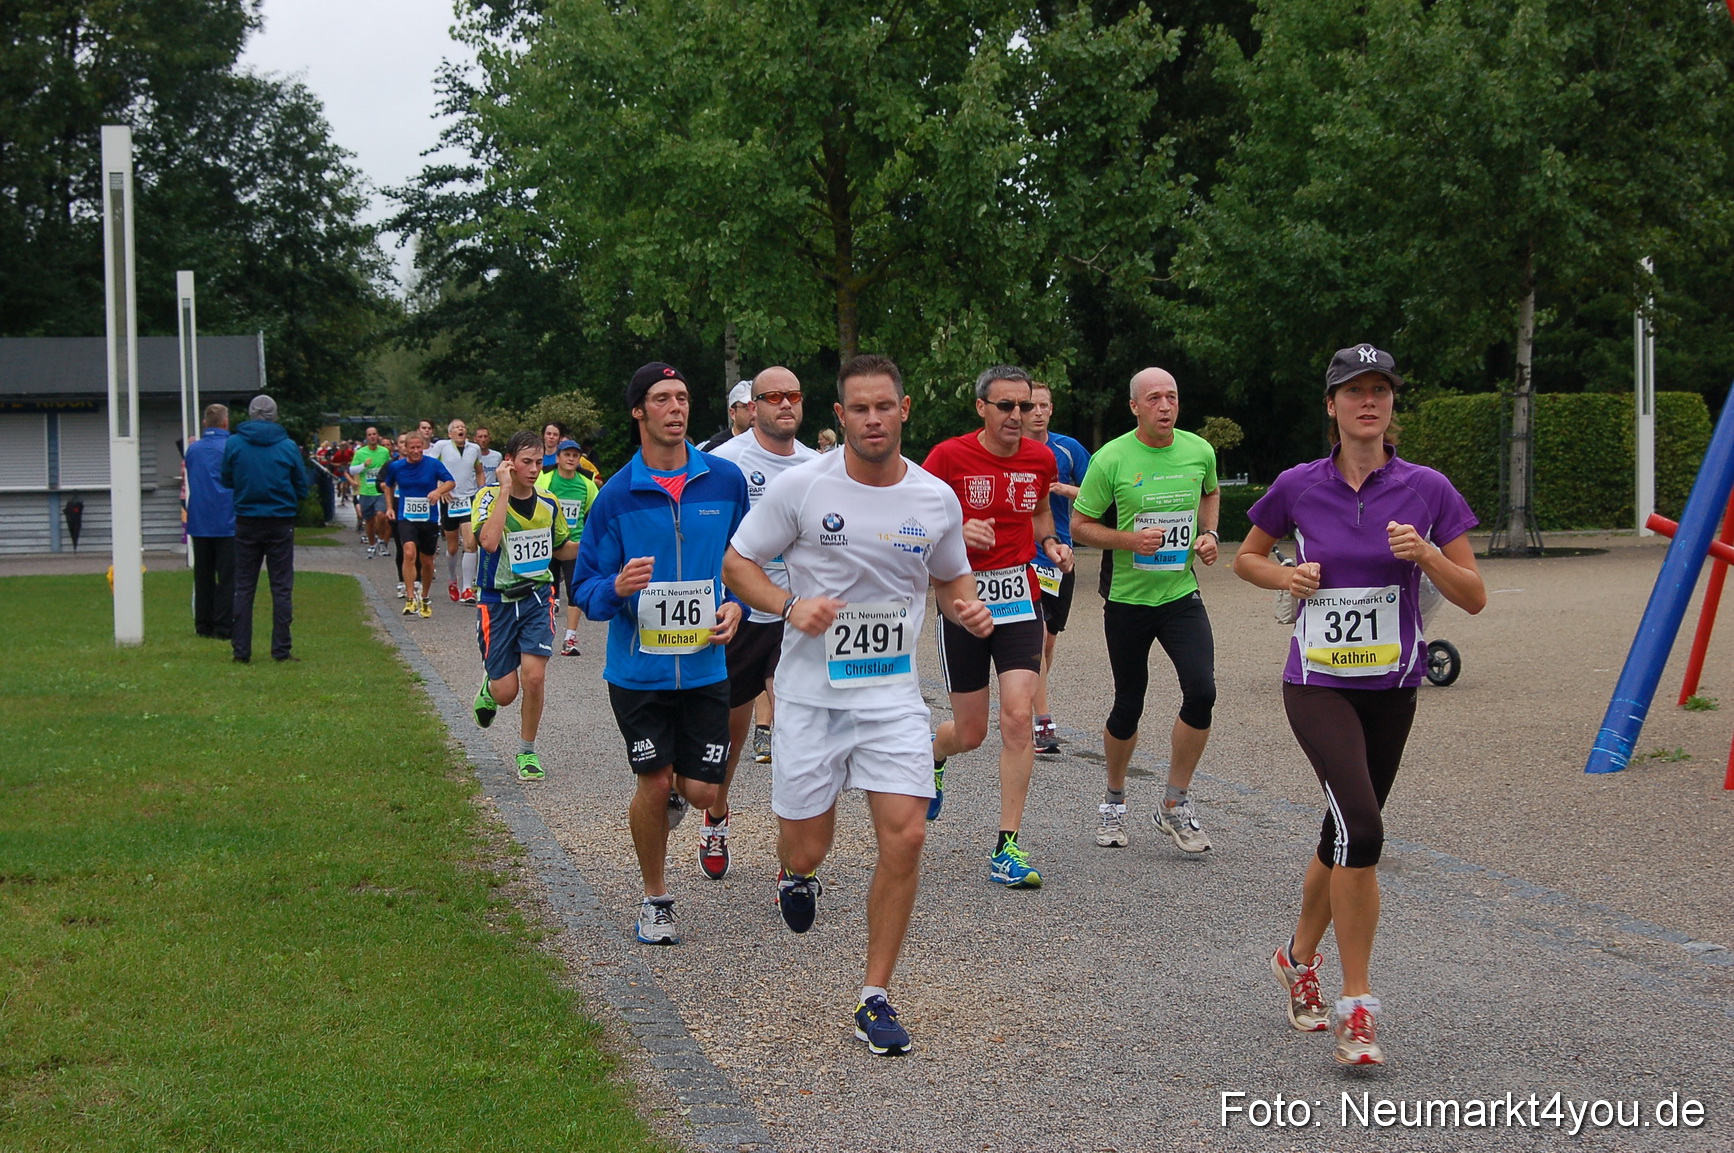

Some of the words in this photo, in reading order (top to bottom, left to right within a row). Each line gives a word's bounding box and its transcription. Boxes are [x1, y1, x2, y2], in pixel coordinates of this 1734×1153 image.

[1357, 347, 1378, 363] NY
[970, 490, 990, 499] NEU
[406, 503, 428, 513] 3056
[1135, 517, 1157, 525] PARTL
[1158, 517, 1187, 525] Neumarkt
[513, 540, 549, 561] 3125
[1154, 554, 1177, 563] Klaus
[667, 588, 703, 596] Neumarkt
[976, 575, 1025, 602] 2963
[1307, 598, 1338, 607] PARTL
[1339, 595, 1383, 606] Neumarkt
[655, 598, 701, 627] 146
[858, 611, 899, 620] Neumarkt
[1324, 608, 1378, 643] 321
[658, 632, 698, 645] Michael
[834, 621, 904, 656] 2491
[1331, 650, 1377, 665] Kathrin
[845, 661, 895, 677] Christian
[702, 743, 724, 763] 33
